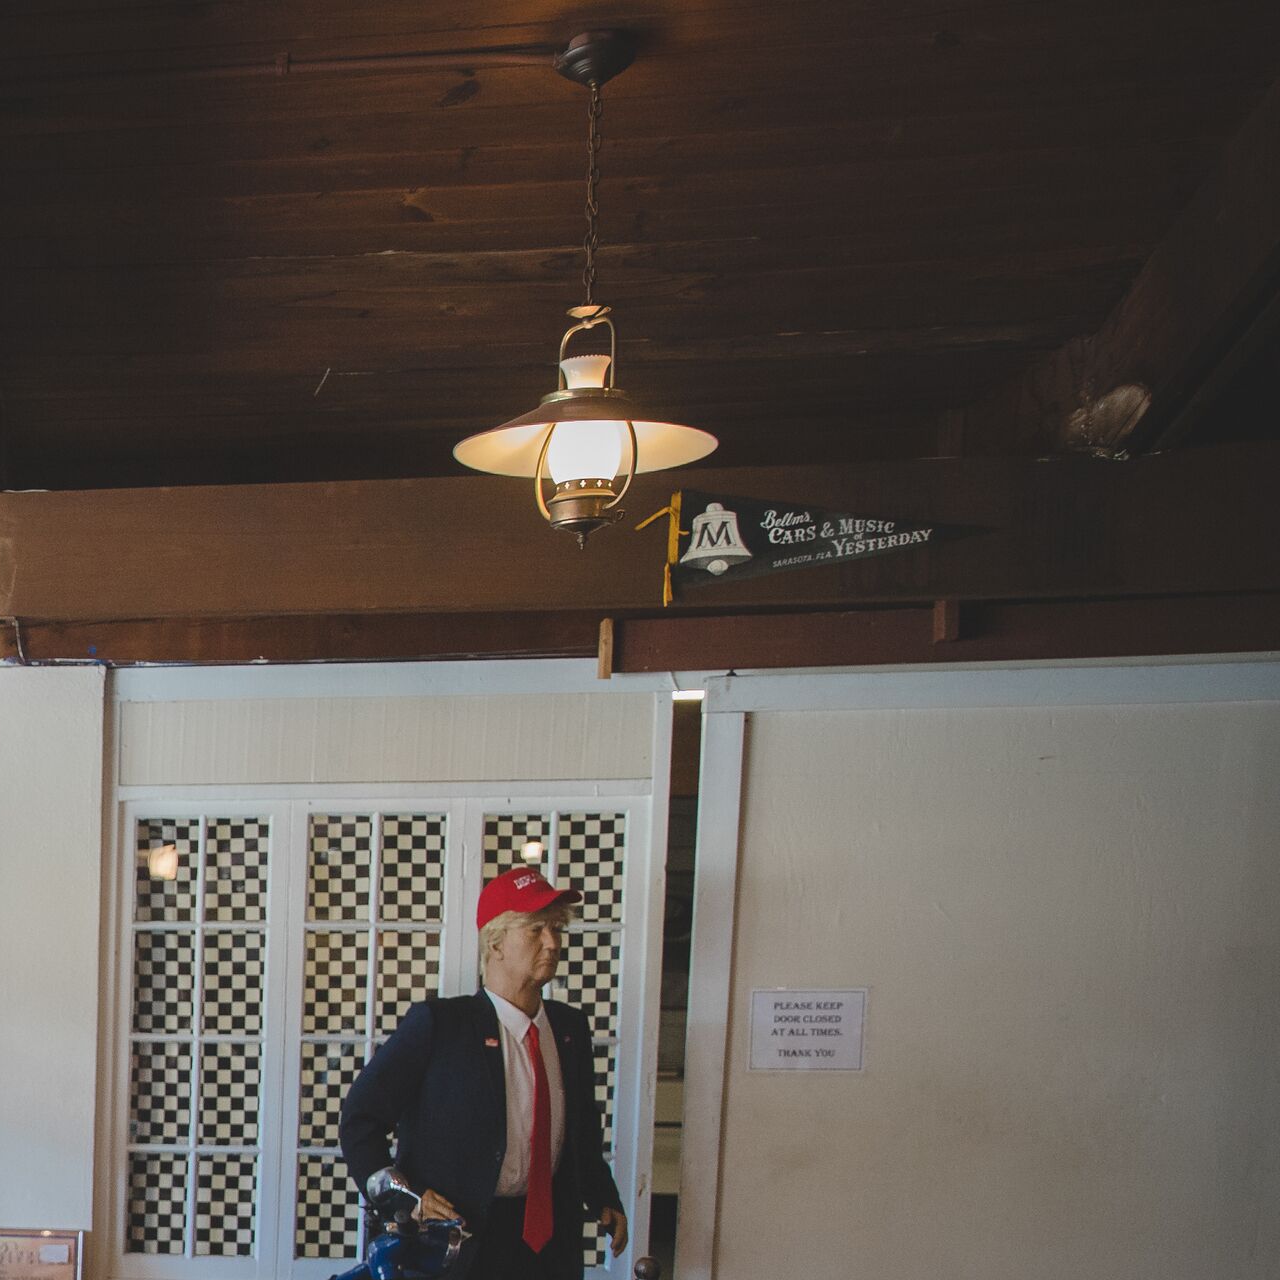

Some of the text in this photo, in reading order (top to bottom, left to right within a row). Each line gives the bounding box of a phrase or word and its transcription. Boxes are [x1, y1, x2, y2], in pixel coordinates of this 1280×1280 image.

[768, 518, 895, 545] CARS & MUSIC
[831, 529, 933, 558] YESTERDAY
[773, 1001, 844, 1011] PLEASE KEEP
[773, 1014, 842, 1024] DOOR CLOSED
[771, 1028, 785, 1037] AT
[787, 1028, 808, 1037] ALL
[778, 1049, 837, 1058] THANK YOU
